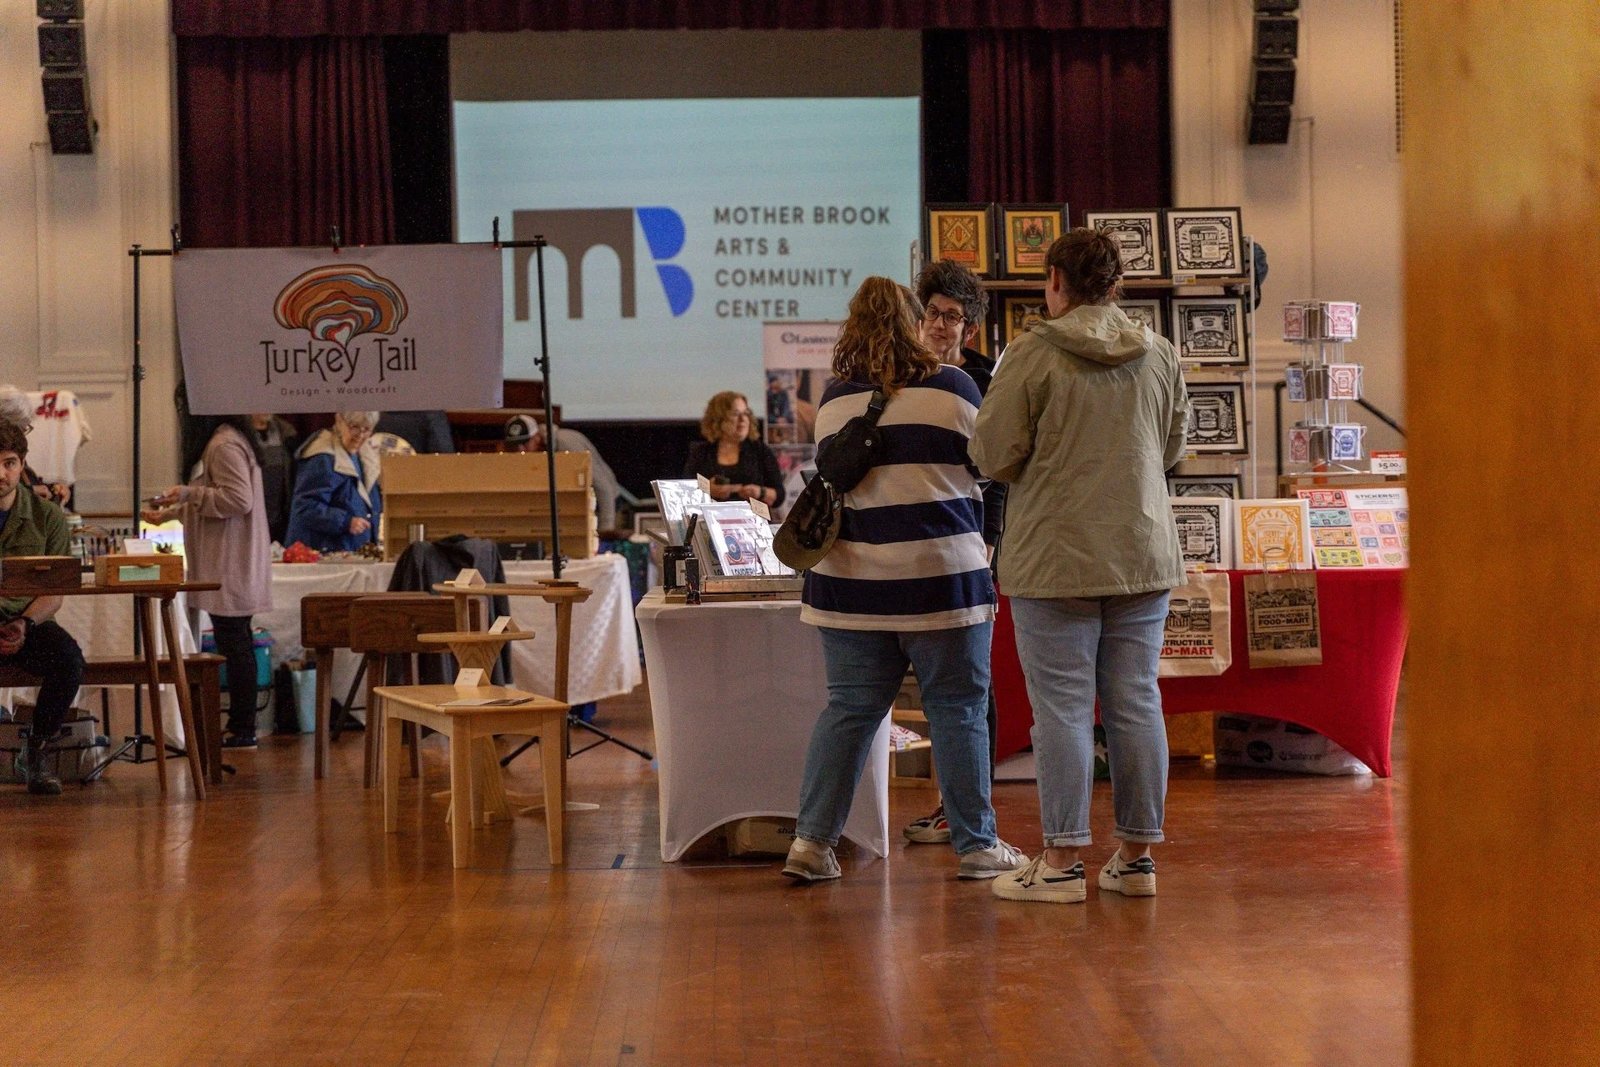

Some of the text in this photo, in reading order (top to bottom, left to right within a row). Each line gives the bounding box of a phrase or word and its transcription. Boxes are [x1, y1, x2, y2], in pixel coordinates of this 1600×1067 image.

[714, 206, 891, 225] MOTHER BROOK
[715, 238, 790, 256] ARTS &
[715, 268, 853, 287] COMMUNITY
[716, 299, 800, 318] CENTER
[259, 338, 418, 385] Turkey Tail
[280, 387, 321, 397] Design
[337, 385, 397, 396] Woodcraft
